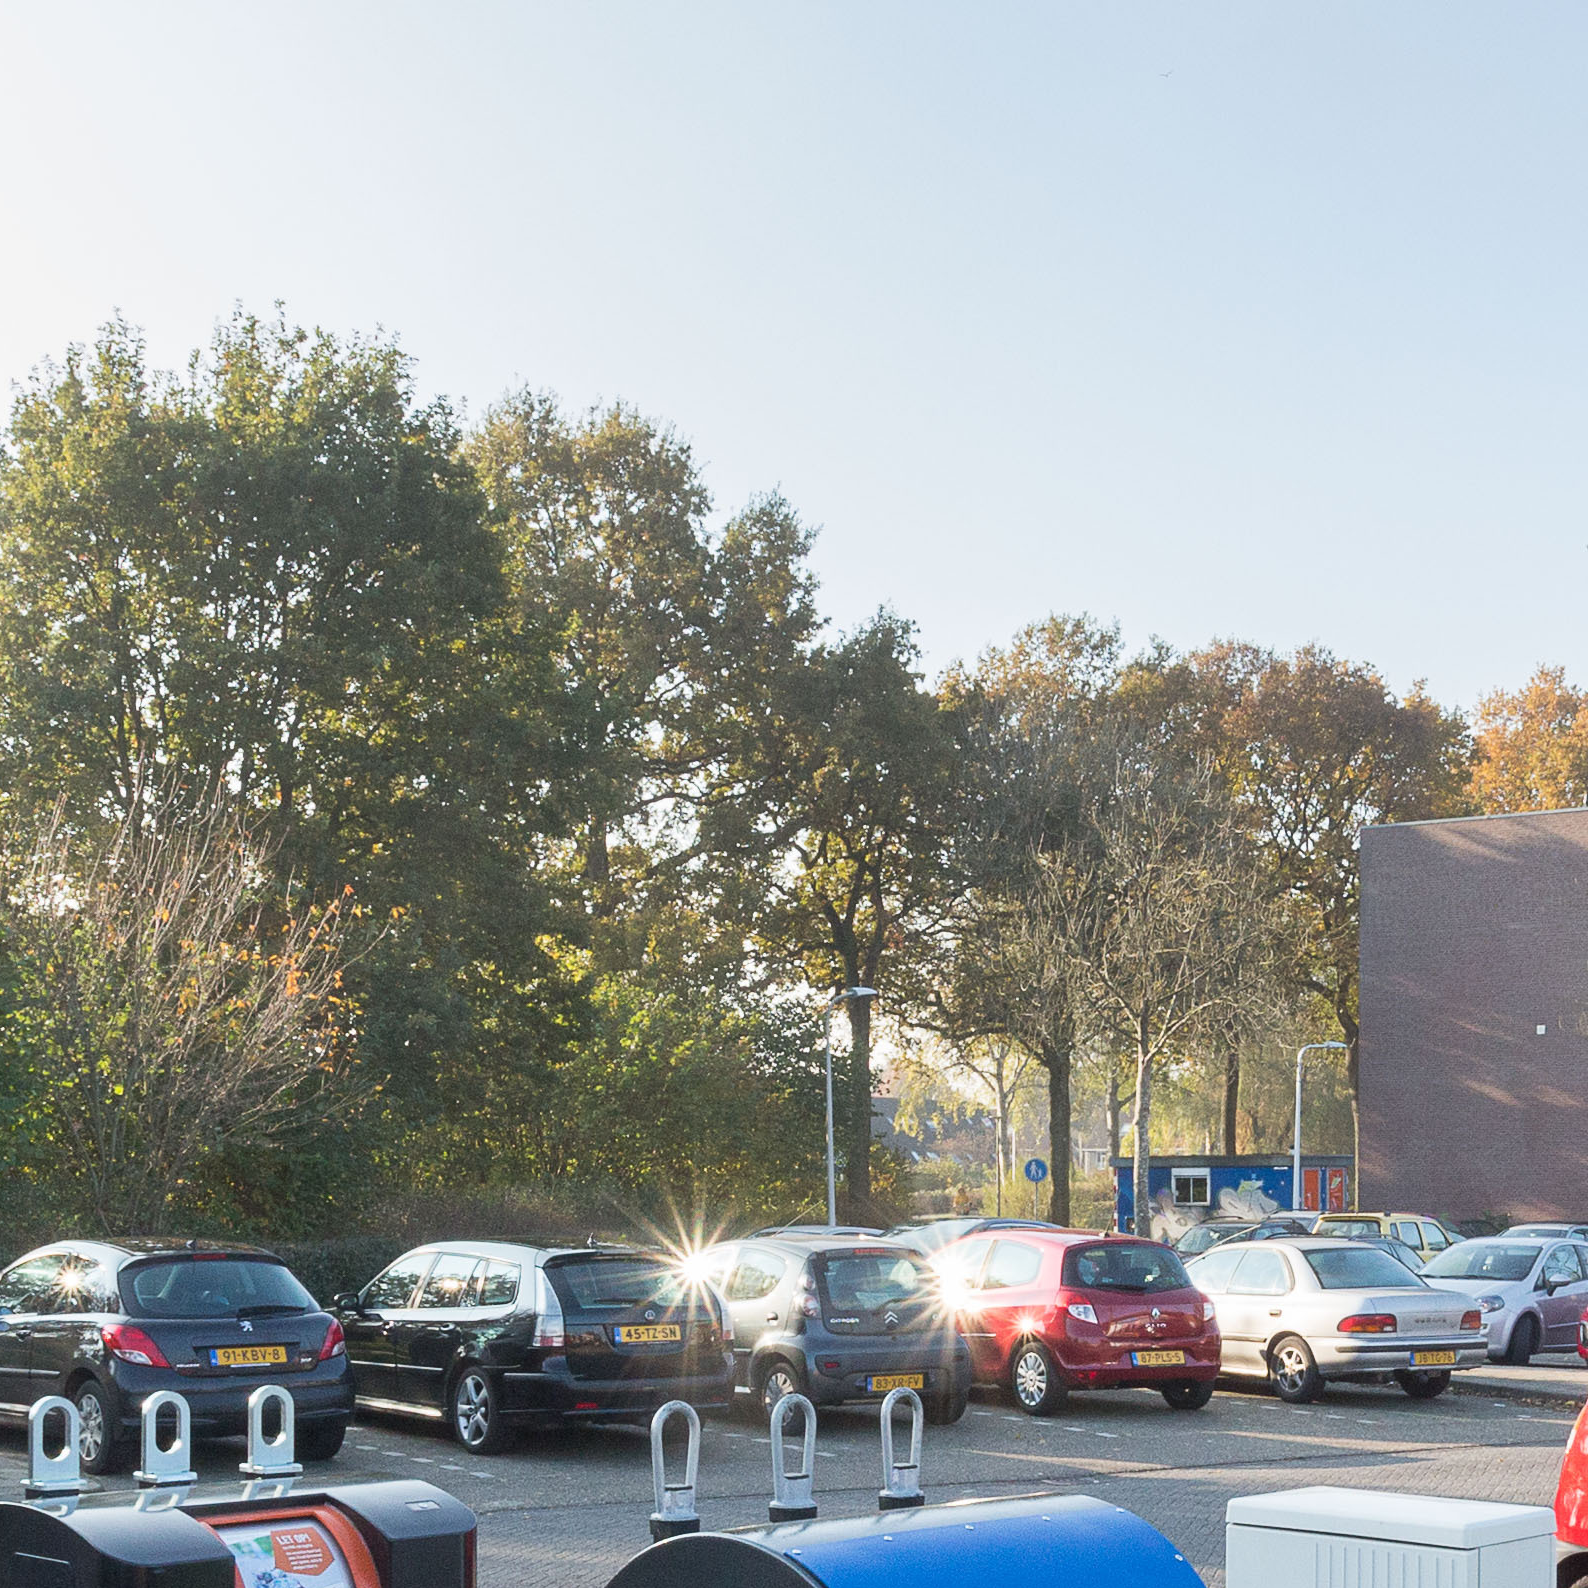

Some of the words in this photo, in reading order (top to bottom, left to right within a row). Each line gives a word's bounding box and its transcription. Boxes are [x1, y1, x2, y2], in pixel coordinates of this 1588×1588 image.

[624, 1325, 678, 1341] 45-TZ-SN
[222, 1348, 281, 1363] 91-KBV-8
[875, 1373, 921, 1390] 83-XR-FV
